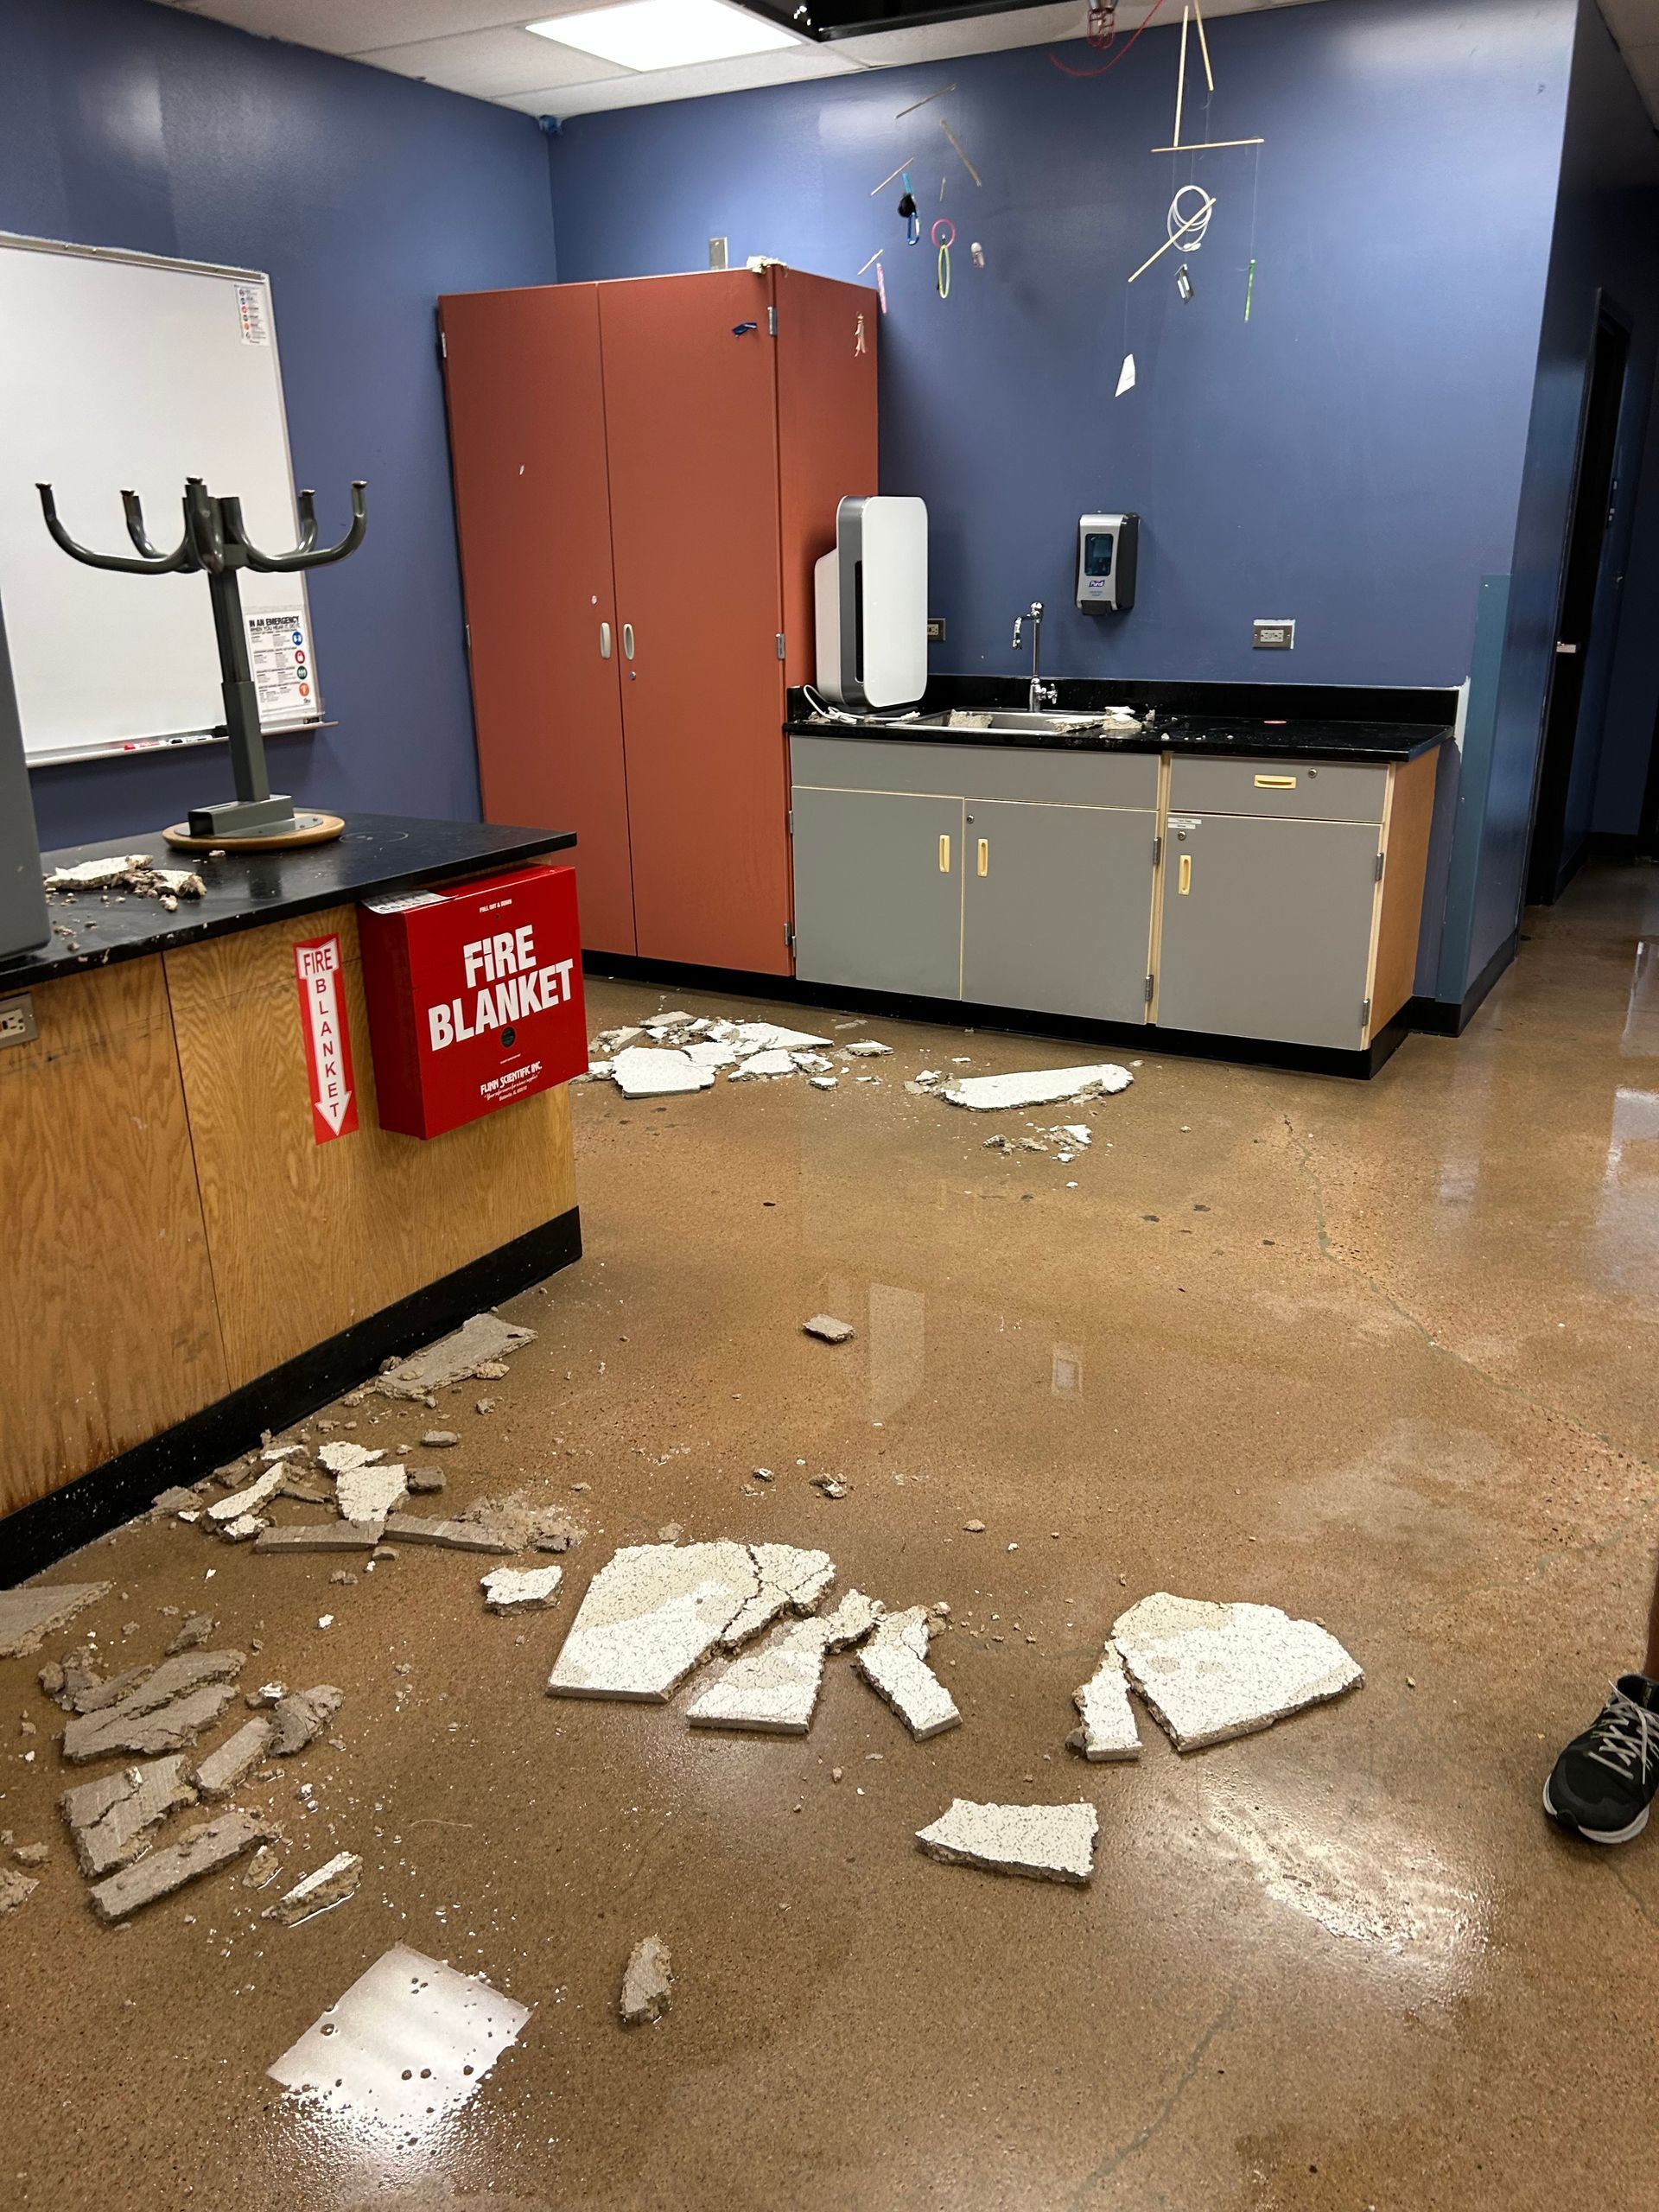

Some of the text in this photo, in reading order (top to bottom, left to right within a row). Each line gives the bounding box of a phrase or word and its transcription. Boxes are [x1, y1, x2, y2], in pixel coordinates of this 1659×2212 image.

[265, 616, 300, 626] EMERGENCY
[303, 948, 334, 976] FIRE
[463, 925, 537, 988] FIRE
[428, 958, 574, 1052] BLANKET
[315, 977, 340, 1118] BLANKET
[499, 1065, 531, 1089] SCIENTIFIC
